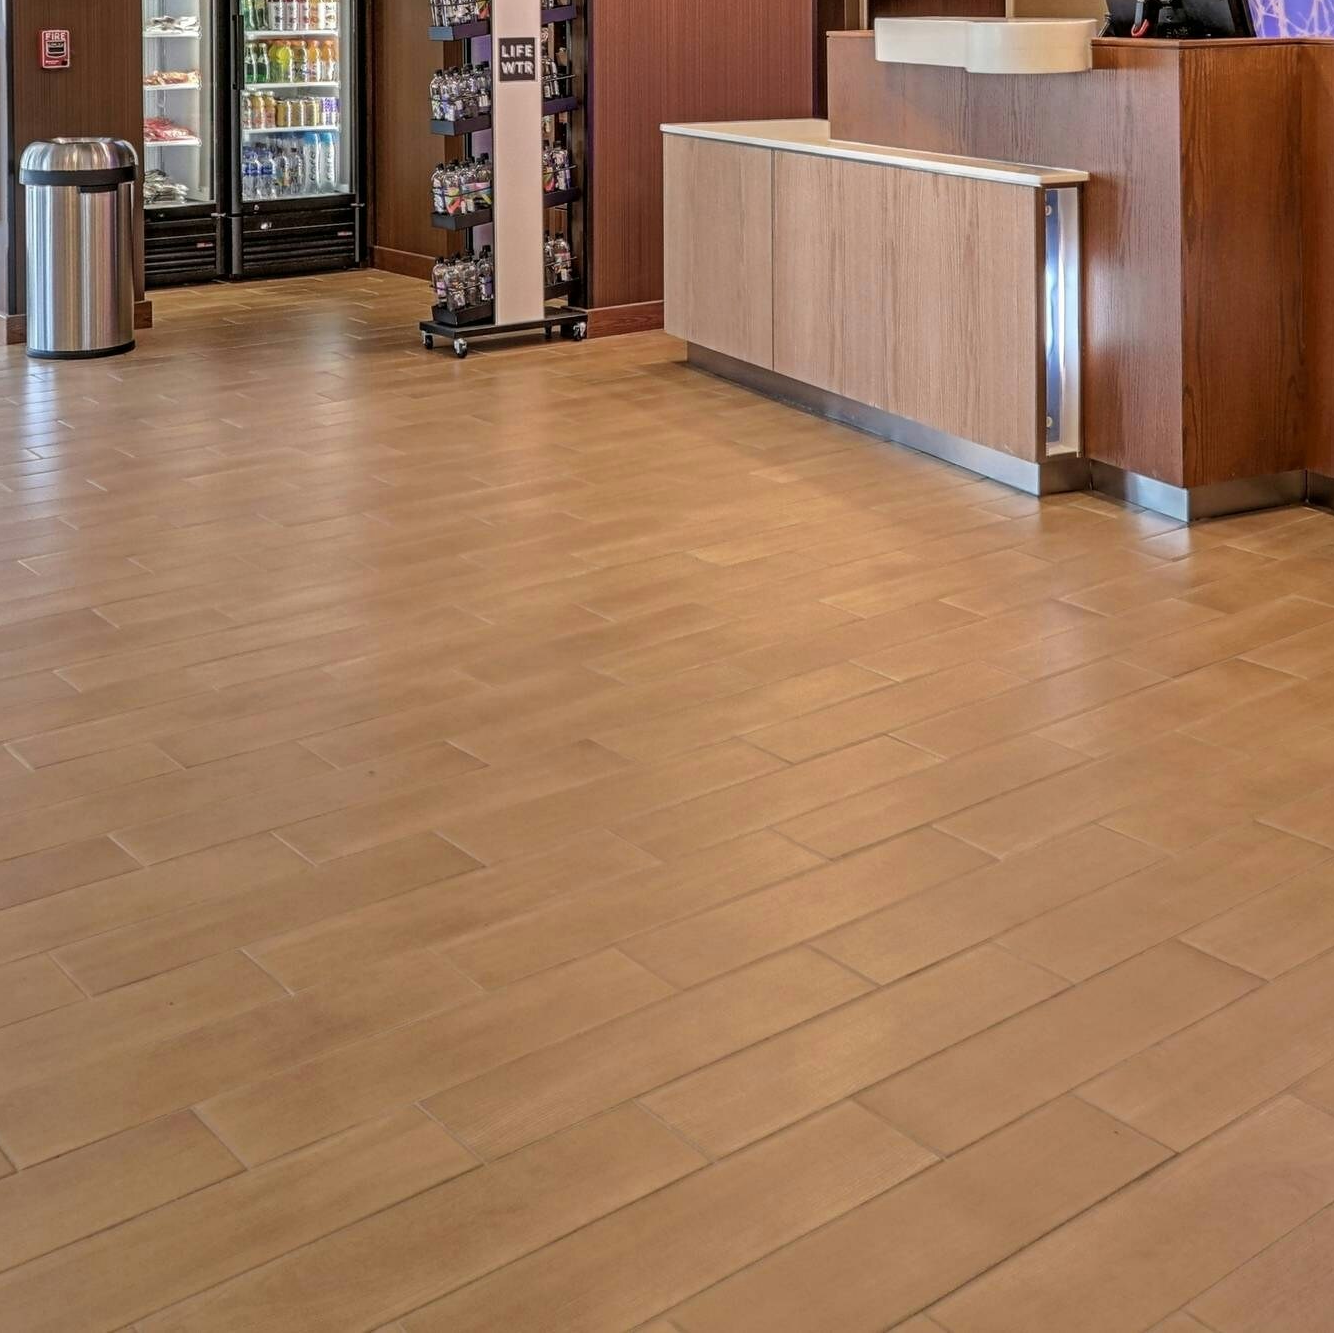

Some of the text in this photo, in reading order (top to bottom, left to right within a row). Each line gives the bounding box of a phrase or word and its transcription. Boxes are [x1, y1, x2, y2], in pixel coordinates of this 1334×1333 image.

[45, 32, 67, 41] FIRE
[501, 44, 534, 57] LIFE
[501, 60, 534, 74] WTR
